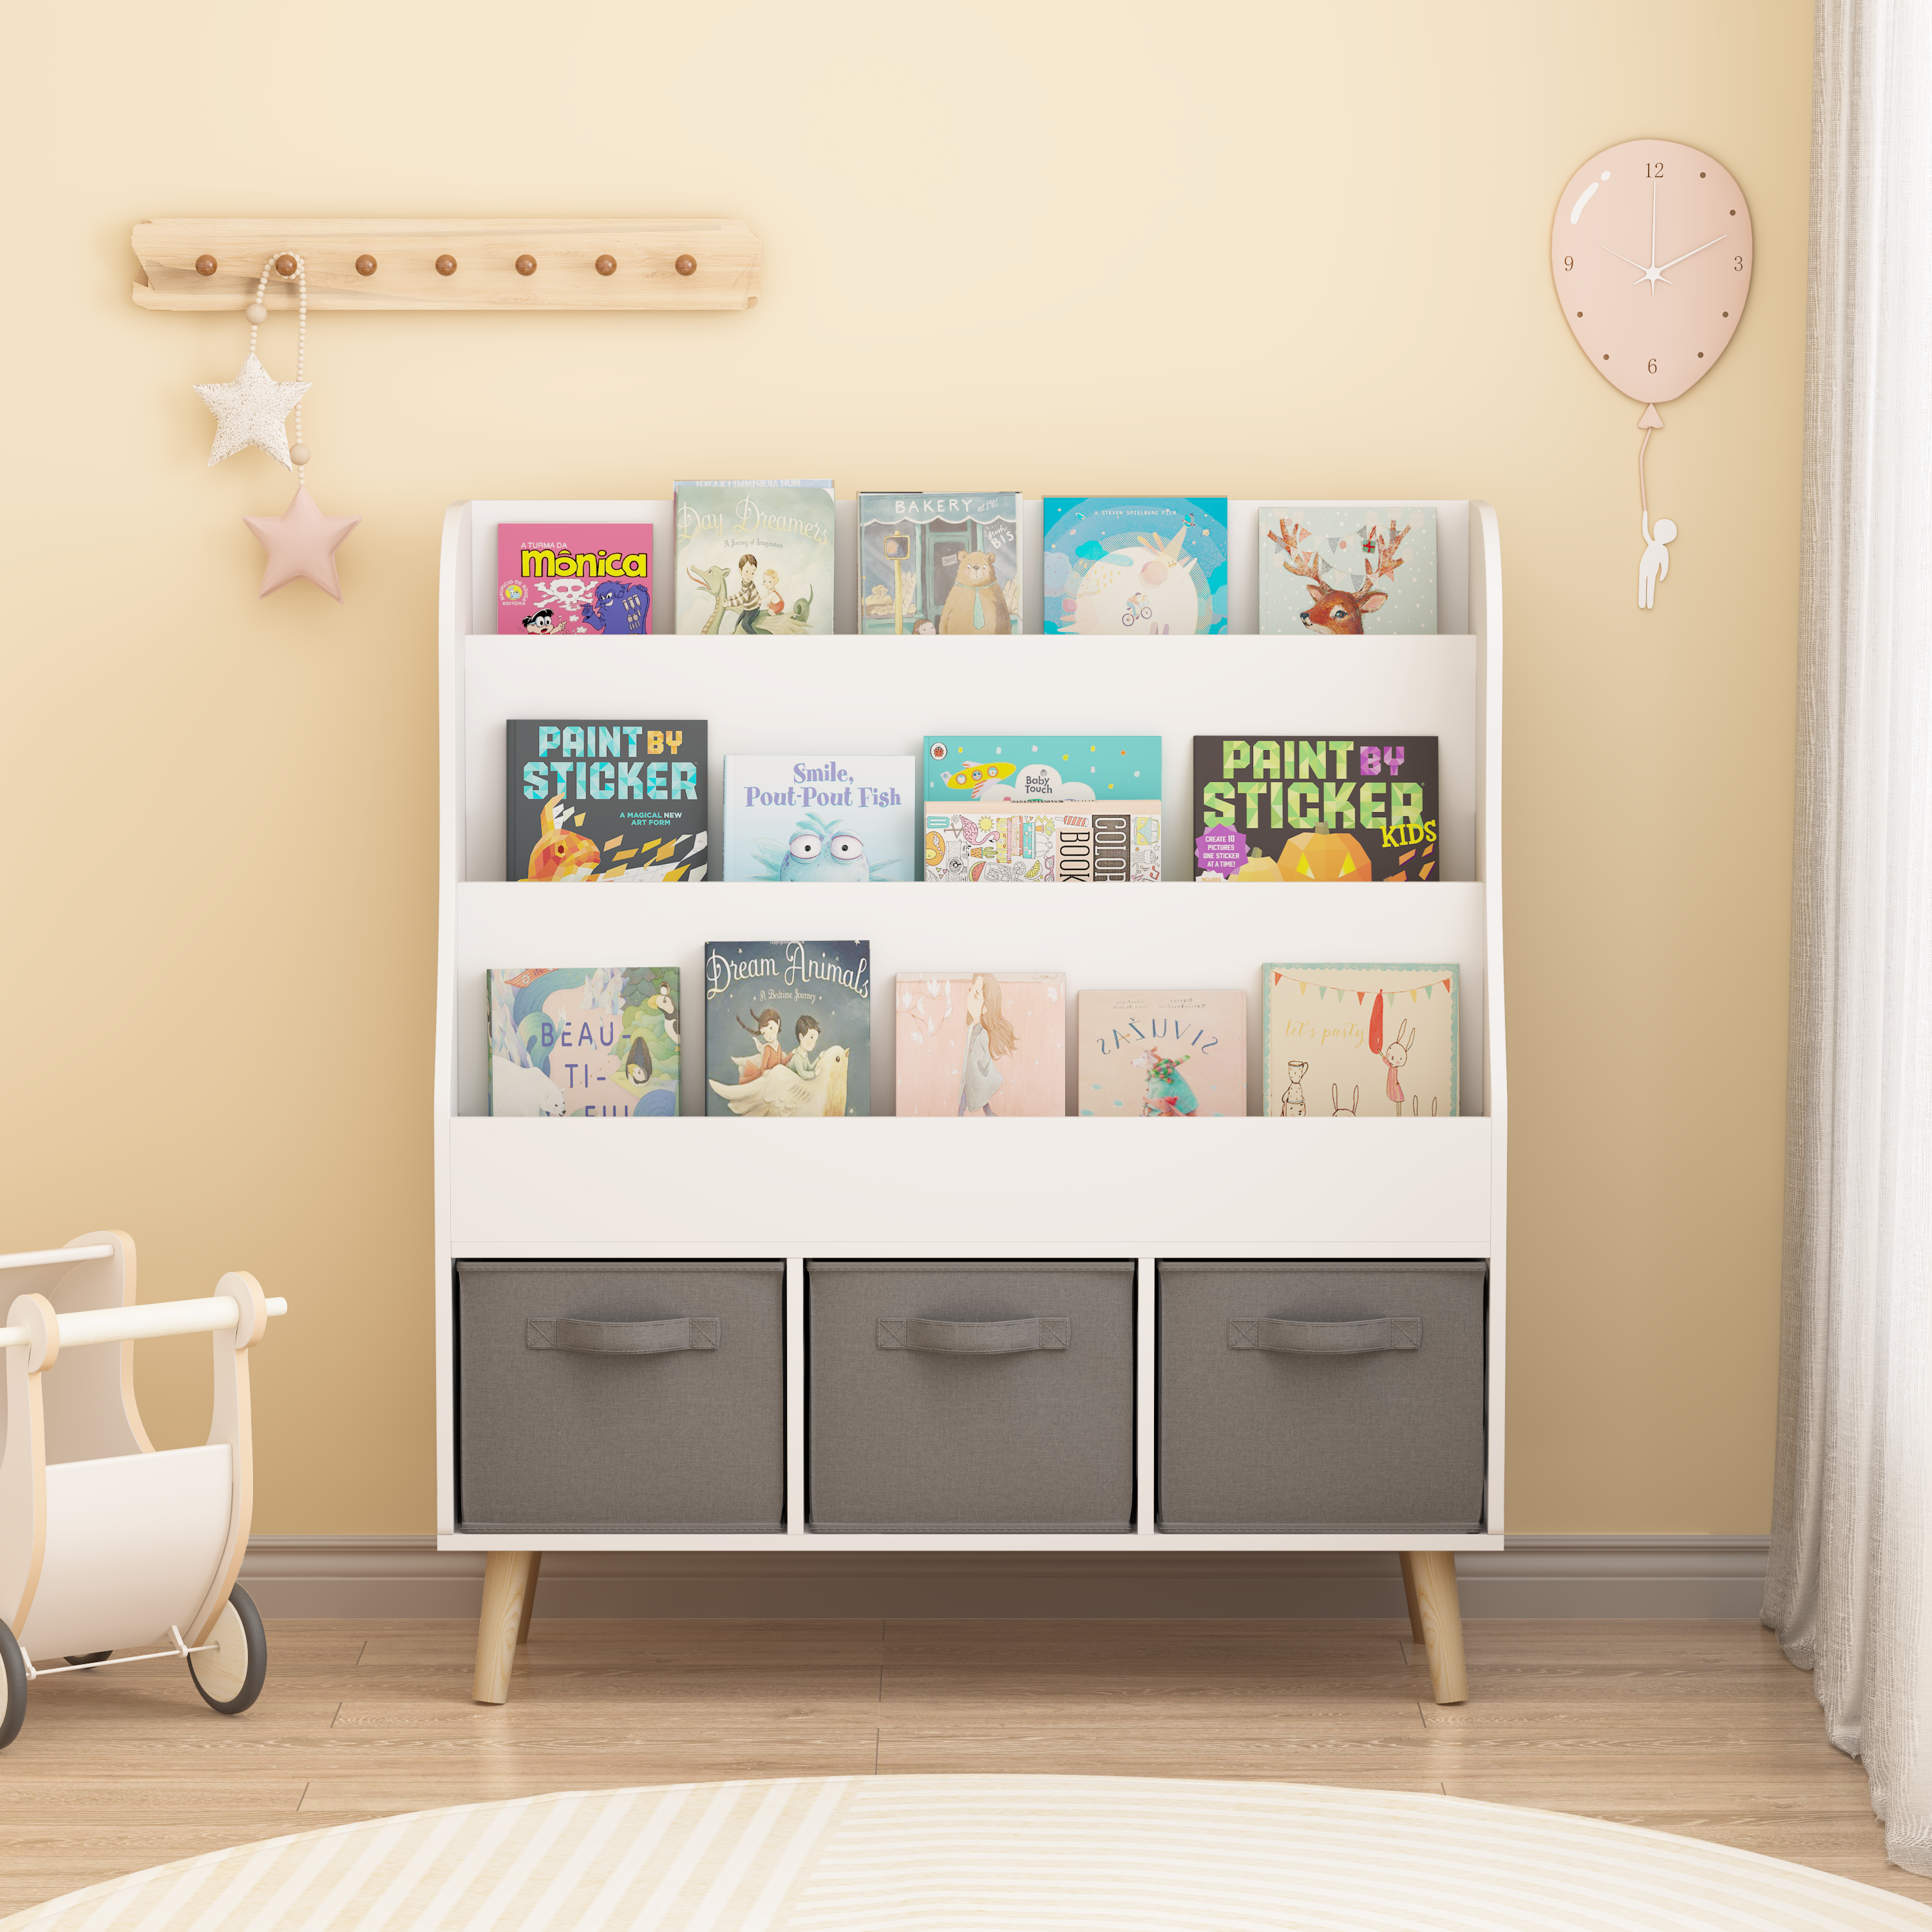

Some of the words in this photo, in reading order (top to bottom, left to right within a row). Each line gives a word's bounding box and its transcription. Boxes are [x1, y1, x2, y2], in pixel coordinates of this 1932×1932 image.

[1645, 162, 1664, 178] 12
[1564, 256, 1574, 271] 9
[1734, 256, 1743, 271] 3
[1647, 359, 1657, 374] 6
[895, 499, 972, 513] BAKERY
[677, 501, 723, 544] Day
[732, 494, 828, 545] Dreamers
[988, 524, 1008, 540] fresh
[990, 531, 1016, 549] BIS
[724, 540, 730, 548] A
[756, 538, 783, 549] Imagination
[499, 580, 513, 601] MAURICIO
[539, 726, 643, 757] PAINT
[647, 730, 683, 754] BY
[1223, 741, 1354, 779] PAINT
[1360, 746, 1405, 775] BY
[523, 761, 698, 800] STICKER
[793, 761, 854, 784] Smile,
[1026, 775, 1050, 786] Baby
[743, 786, 853, 808] Pout-Pout
[857, 786, 902, 808] Fish
[1025, 784, 1052, 794] Touch
[1204, 781, 1425, 829] STICKER
[1379, 819, 1437, 848] KIDS
[1060, 831, 1090, 882] BOOK
[1095, 817, 1127, 882] COLOR
[706, 948, 779, 1000] Dream
[784, 942, 869, 998] Animals
[759, 990, 766, 1001] A
[768, 989, 793, 999] Bedtime
[793, 988, 817, 1004] Journey
[1285, 1019, 1318, 1038] let's
[1321, 1021, 1365, 1048] party
[565, 1064, 606, 1088] TI-
